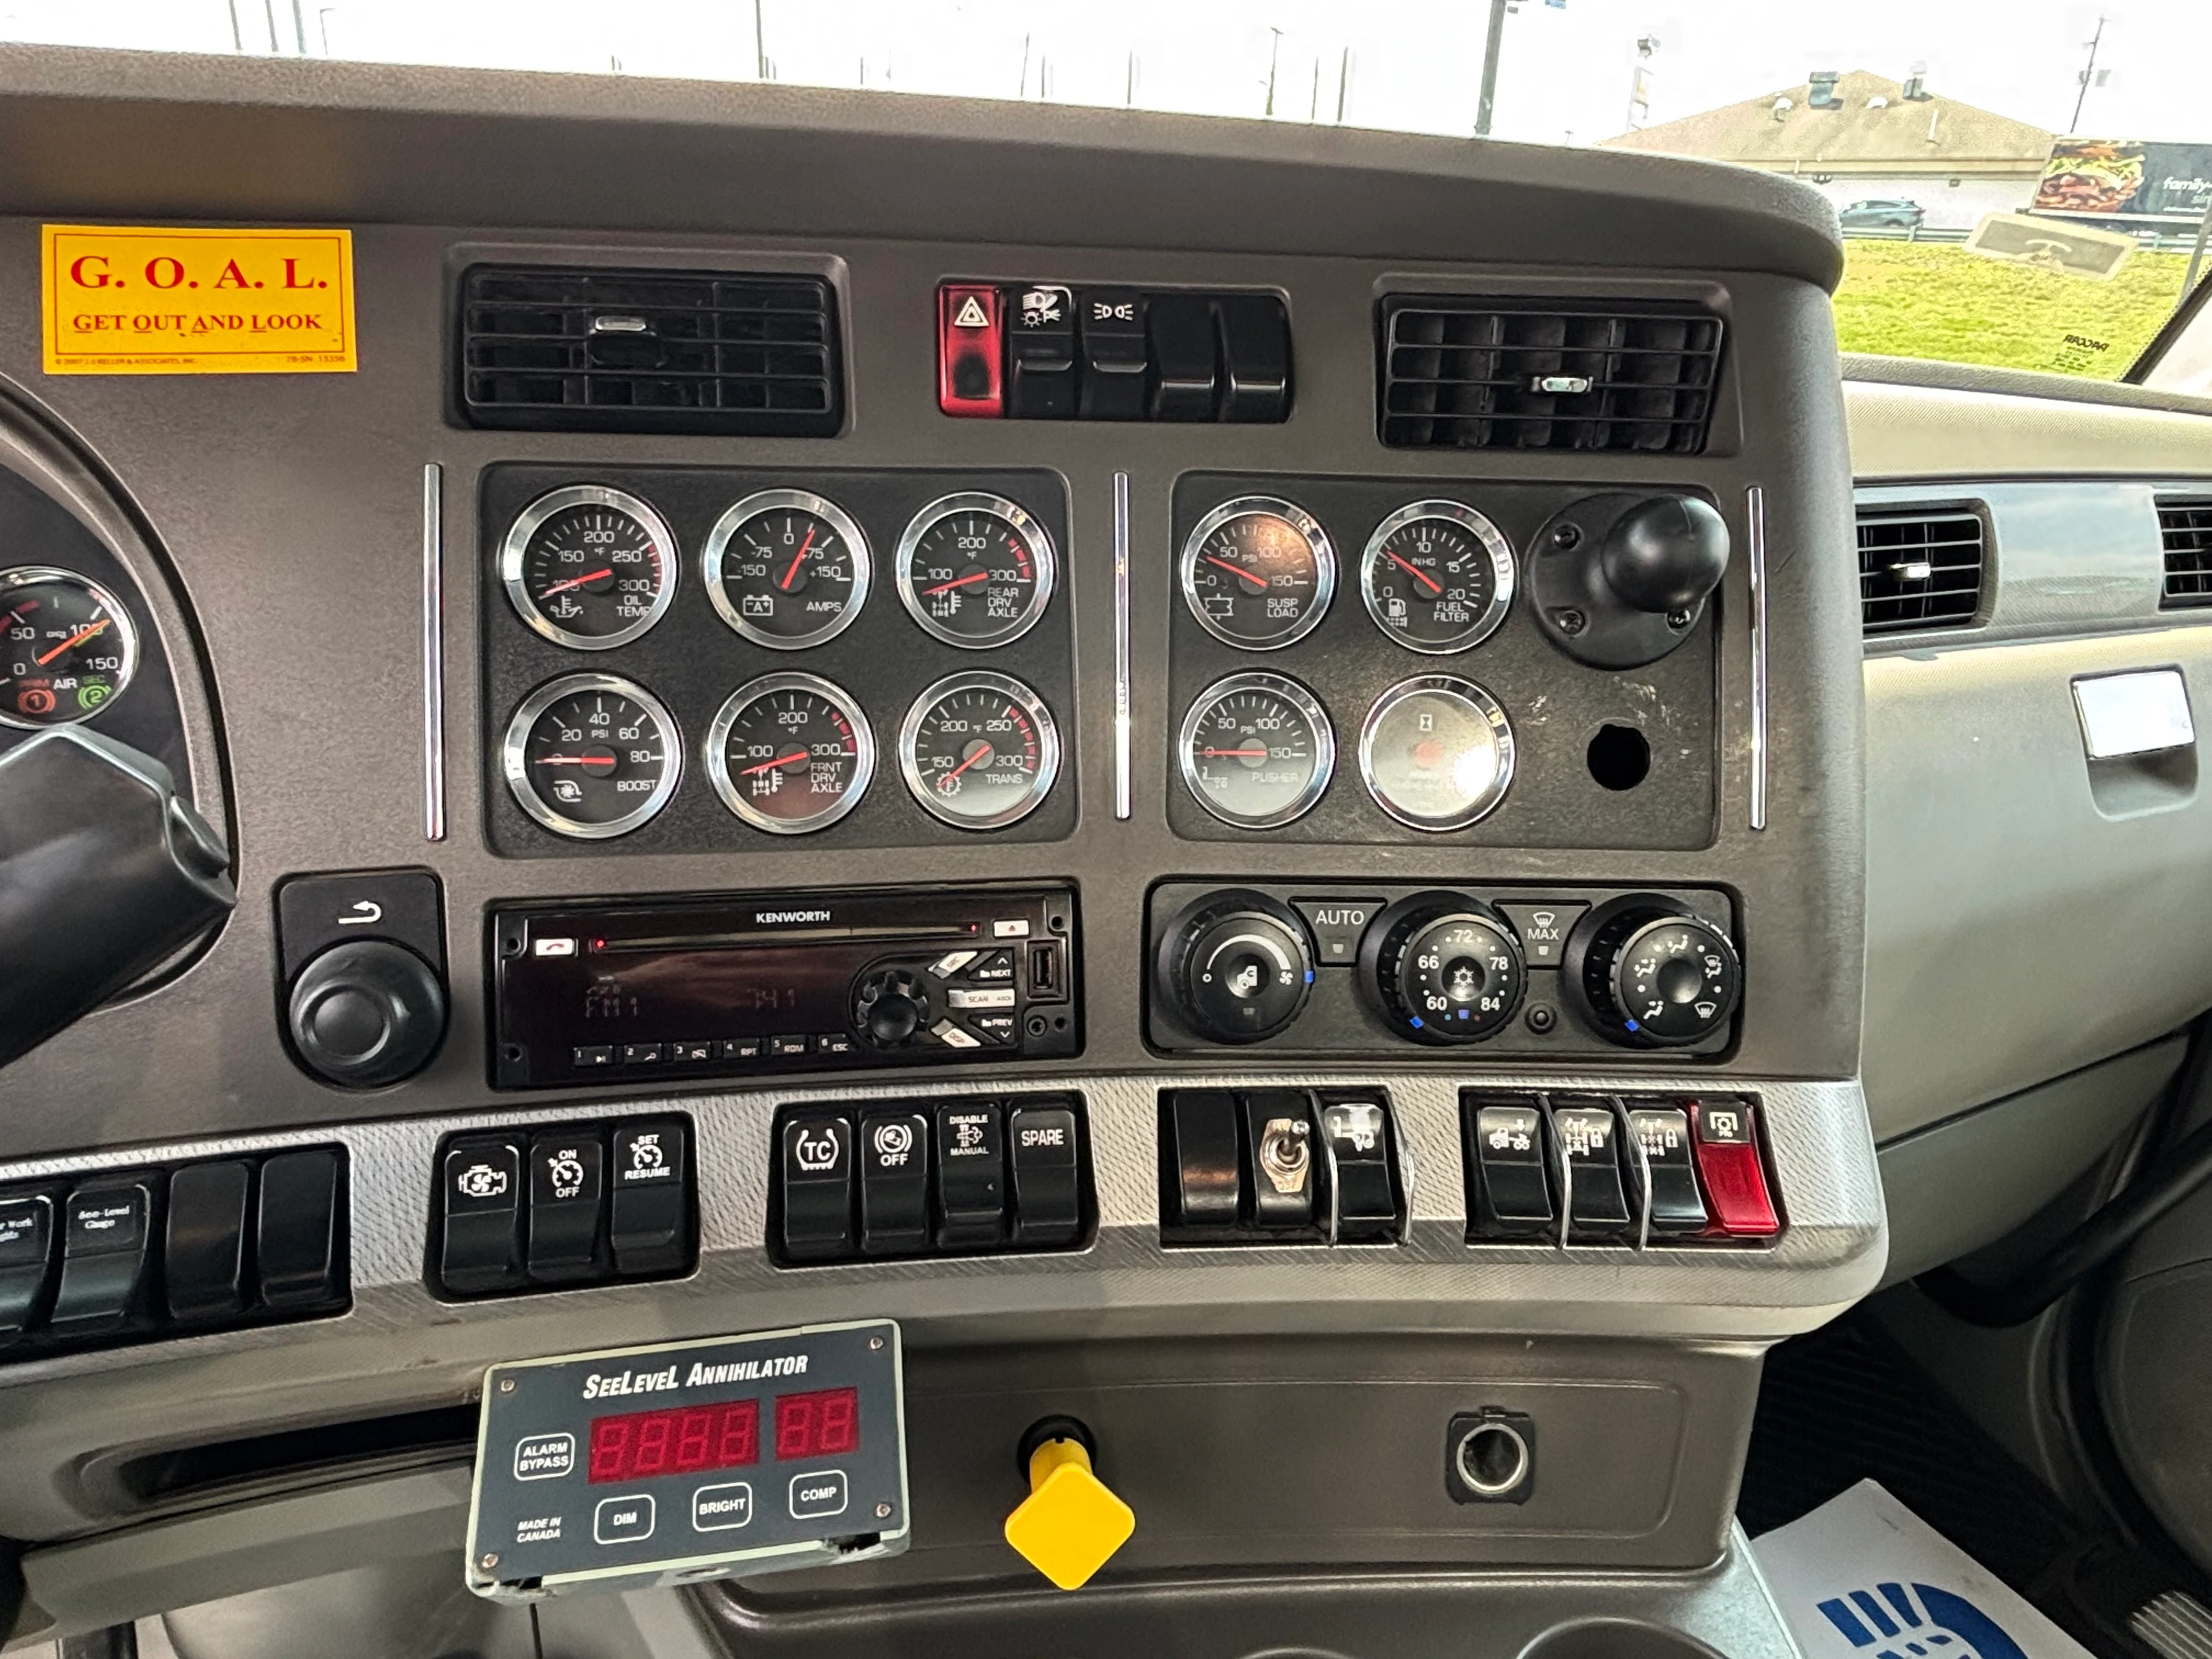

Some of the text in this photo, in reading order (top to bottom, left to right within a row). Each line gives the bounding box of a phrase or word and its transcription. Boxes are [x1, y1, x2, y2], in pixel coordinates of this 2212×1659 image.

[70, 256, 328, 289] G. O. A. L.
[74, 314, 322, 332] GET OUT AND LOOK
[584, 531, 615, 543] 200
[783, 533, 794, 545] 0
[958, 537, 986, 549] 200
[751, 546, 772, 559] -75
[1220, 546, 1238, 558] 50
[1256, 546, 1282, 558] 100
[1415, 541, 1432, 553] 10
[558, 550, 585, 562] 150
[612, 550, 642, 563] 250
[1242, 554, 1257, 563] PSI
[1387, 558, 1396, 571] 5
[1447, 561, 1460, 573] 15
[810, 566, 841, 578] +150
[928, 568, 953, 580] 100
[989, 569, 1017, 582] 300
[619, 579, 650, 591] 300
[1207, 575, 1217, 586] 0
[1271, 575, 1293, 587] 150
[988, 588, 1019, 597] REAR
[1383, 586, 1393, 598] 0
[1447, 588, 1465, 600] 20
[623, 595, 642, 606] OIL
[806, 601, 842, 612] AMPS
[988, 597, 1013, 607] DRV
[1267, 598, 1299, 608] SUSP
[1436, 601, 1464, 612] FUEL
[616, 606, 652, 617] TEMP
[988, 607, 1018, 618] AXLE
[1267, 608, 1299, 618] LOAD
[1434, 612, 1469, 622] FILTER
[10, 628, 35, 640] 50
[13, 663, 26, 675] 0
[86, 657, 118, 670] 150
[53, 678, 77, 690] AIR
[589, 713, 610, 725] 40
[778, 712, 808, 724] 200
[1218, 718, 1237, 729] 50
[1255, 718, 1280, 730] 100
[940, 720, 967, 732] 200
[986, 720, 1012, 731] 250
[1240, 726, 1255, 735] PSI
[562, 729, 582, 741] 20
[591, 730, 609, 738] PSI
[619, 727, 640, 740] 60
[747, 745, 774, 757] 100
[811, 743, 841, 756] 300
[1268, 747, 1291, 759] 150
[631, 751, 651, 763] 80
[932, 756, 954, 768] 150
[996, 755, 1023, 767] 300
[811, 762, 842, 772] FRNT
[811, 773, 837, 783] DRV
[985, 774, 1023, 785] TRANS
[1252, 772, 1299, 783] PUSHER
[617, 780, 657, 792] BOOST
[811, 783, 843, 793] AXLE
[756, 911, 831, 923] KENWORTH
[1316, 910, 1365, 926] AUTO
[1453, 929, 1474, 943] 72
[1527, 928, 1560, 940] MAX
[1418, 955, 1440, 969] 66
[1489, 957, 1508, 970] 78
[1426, 997, 1447, 1011] 60
[1481, 997, 1500, 1011] 84
[774, 1039, 780, 1048] 5
[577, 1050, 582, 1058] 1
[628, 1047, 634, 1056] 2
[677, 1046, 684, 1054] 3
[950, 1114, 988, 1125] DISABLE
[637, 1134, 659, 1146] SET
[1022, 1129, 1064, 1147] SPARE
[559, 1149, 577, 1160] ON
[804, 1141, 832, 1161] TC
[950, 1147, 990, 1156] MANUAL
[881, 1153, 909, 1167] OFF
[624, 1166, 670, 1180] RESUME
[556, 1187, 580, 1198] OFF
[523, 1442, 568, 1458] ALARM
[520, 1455, 569, 1471] BYPASS
[800, 1486, 837, 1502] COMP
[699, 1498, 746, 1515] BRIGHT
[518, 1516, 562, 1531] MADE IN
[613, 1511, 637, 1526] DIM
[517, 1528, 561, 1543] CANADA
